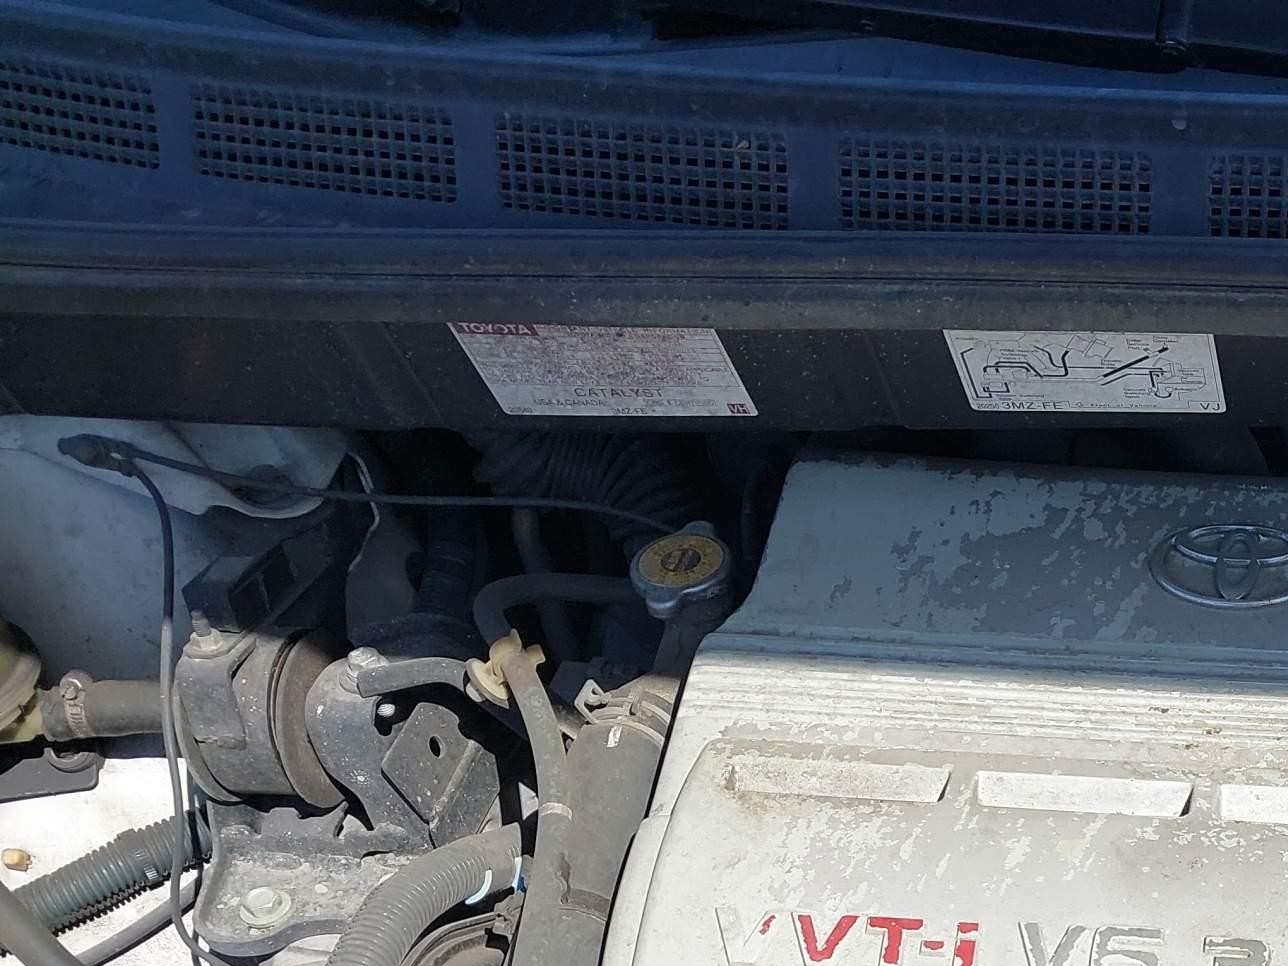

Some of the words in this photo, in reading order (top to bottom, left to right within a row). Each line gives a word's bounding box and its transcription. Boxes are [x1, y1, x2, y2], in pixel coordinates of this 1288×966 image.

[457, 322, 532, 335] TOYOTA
[573, 386, 664, 398] CATALYST
[729, 404, 749, 414] VH
[1001, 400, 1065, 411] 3MZ-FE
[1200, 402, 1221, 411] VJ
